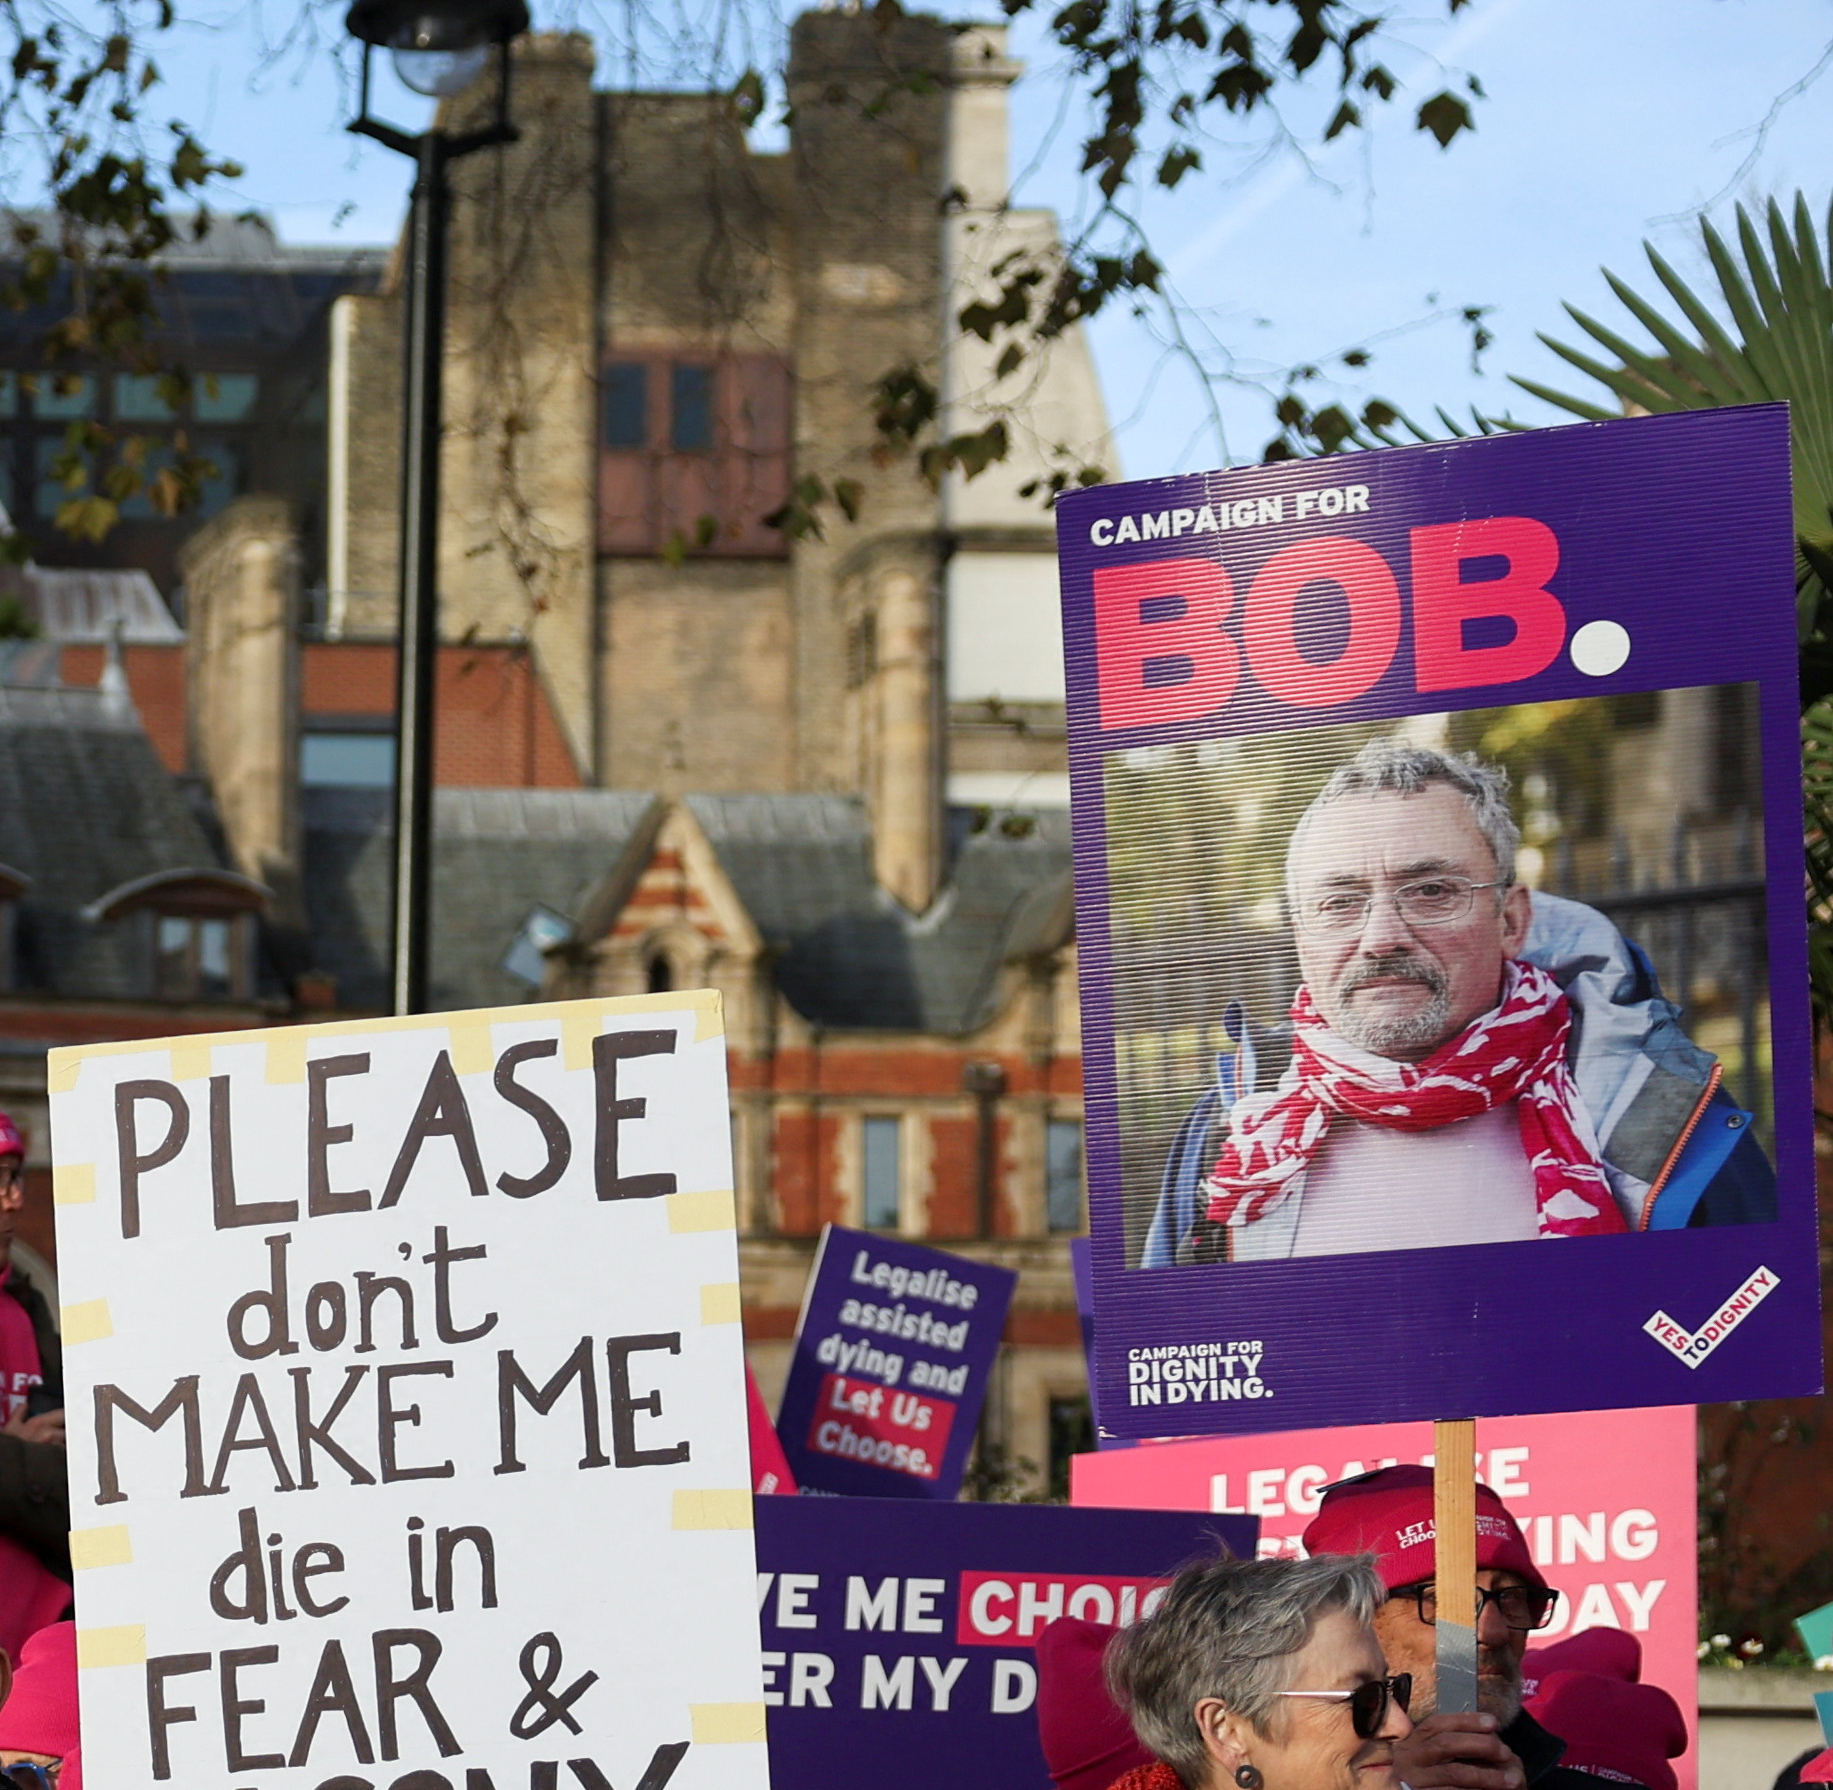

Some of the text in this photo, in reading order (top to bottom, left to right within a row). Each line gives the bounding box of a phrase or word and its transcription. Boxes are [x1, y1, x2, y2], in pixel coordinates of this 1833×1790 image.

[1090, 484, 1370, 546] CAMPAIGN FOR
[1092, 515, 1631, 730] BOB.
[114, 1029, 678, 1239] PLEASE
[227, 1225, 498, 1360] don't
[851, 1250, 978, 1310] Legalise
[839, 1299, 969, 1351] assisted
[1128, 1340, 1264, 1361] CAMPAIGN FOR
[1652, 1316, 1689, 1351] YES
[817, 1333, 969, 1396] dying and
[1129, 1354, 1264, 1384] DIGNITY
[1130, 1377, 1274, 1406] IN DYING.
[92, 1360, 457, 1505] MAKE
[493, 1332, 690, 1475] ME
[831, 1378, 933, 1430] Let Us
[817, 1420, 933, 1475] Choose.
[209, 1508, 498, 1624] die in
[1400, 1530, 1436, 1549] CHOO
[845, 1575, 945, 1633] ME
[146, 1628, 598, 1780] FEAR &
[762, 1651, 968, 1711] ER MY
